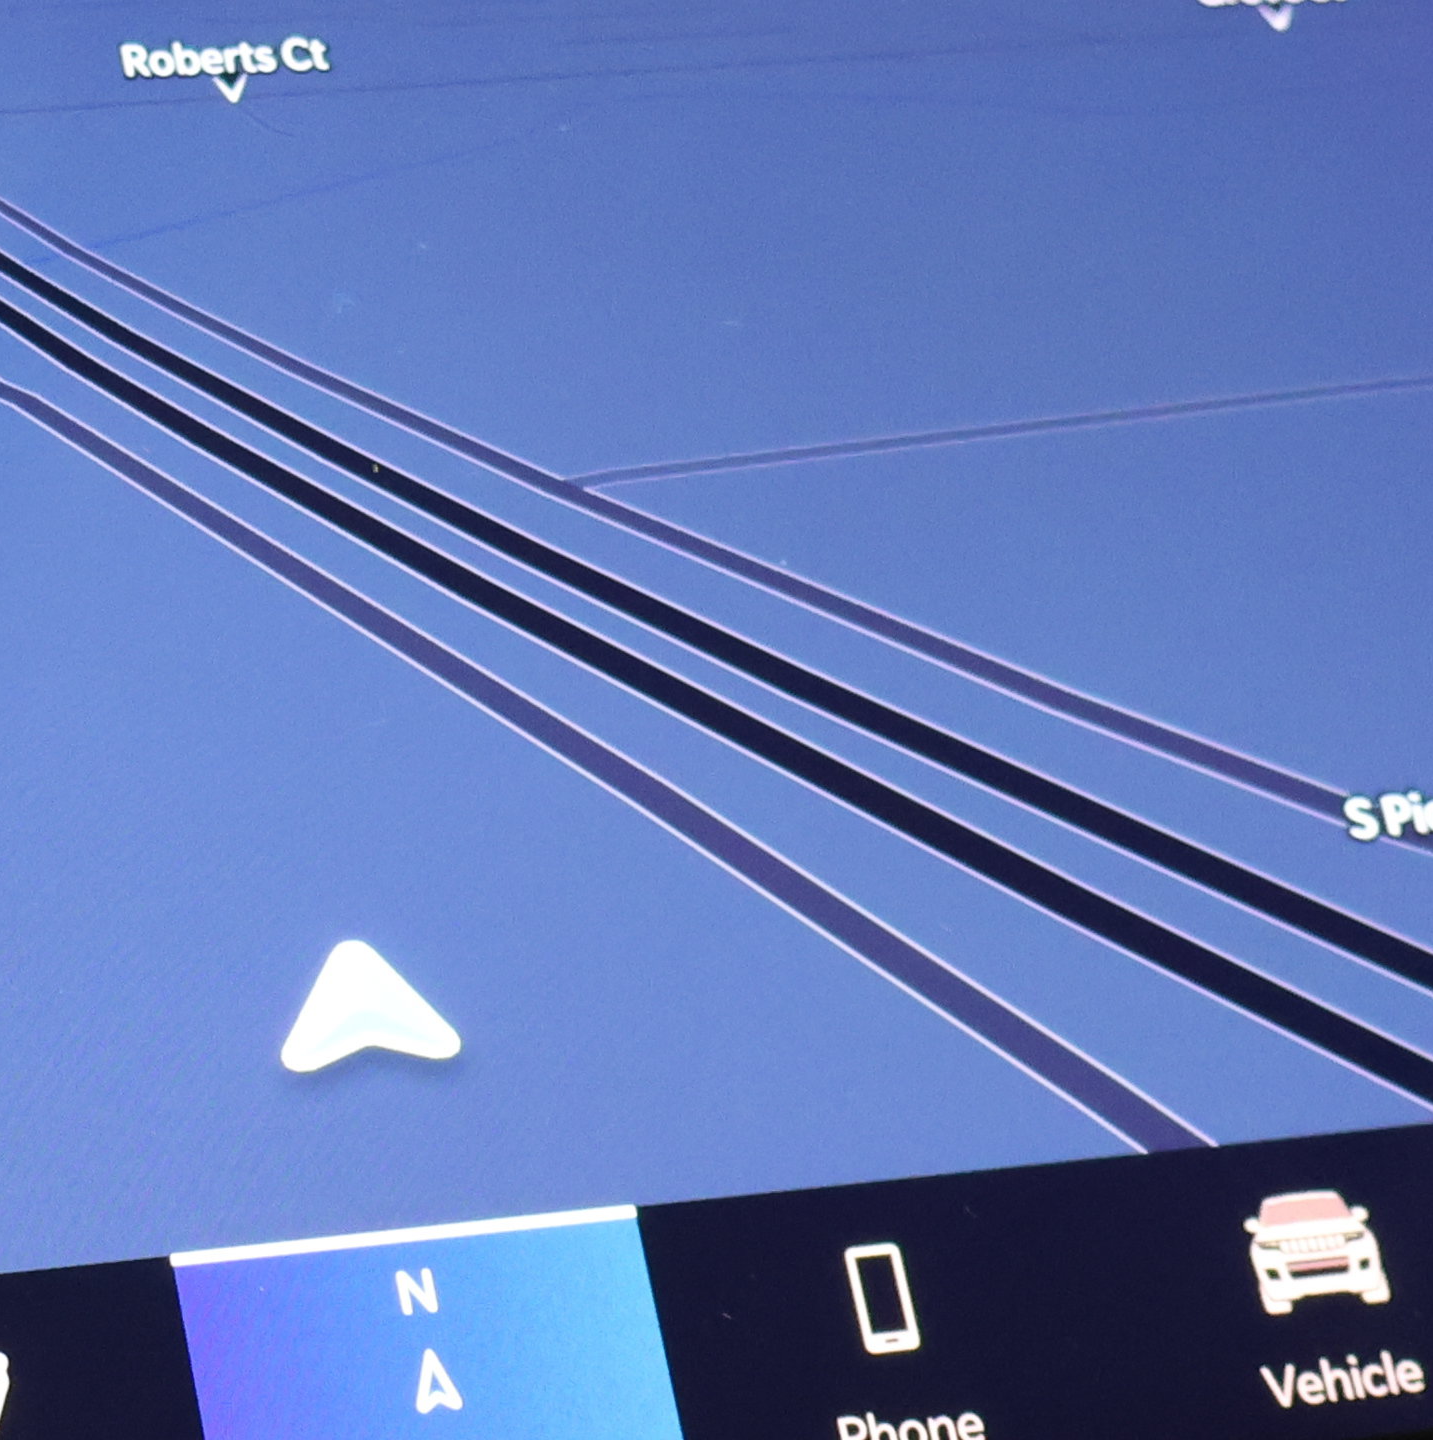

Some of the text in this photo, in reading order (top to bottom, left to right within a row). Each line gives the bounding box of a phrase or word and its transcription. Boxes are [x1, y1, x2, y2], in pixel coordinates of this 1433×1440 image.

[120, 36, 330, 77] Roberts Ct
[1343, 796, 1380, 841] S
[394, 1268, 438, 1317] N
[1259, 1351, 1425, 1408] Vehicle
